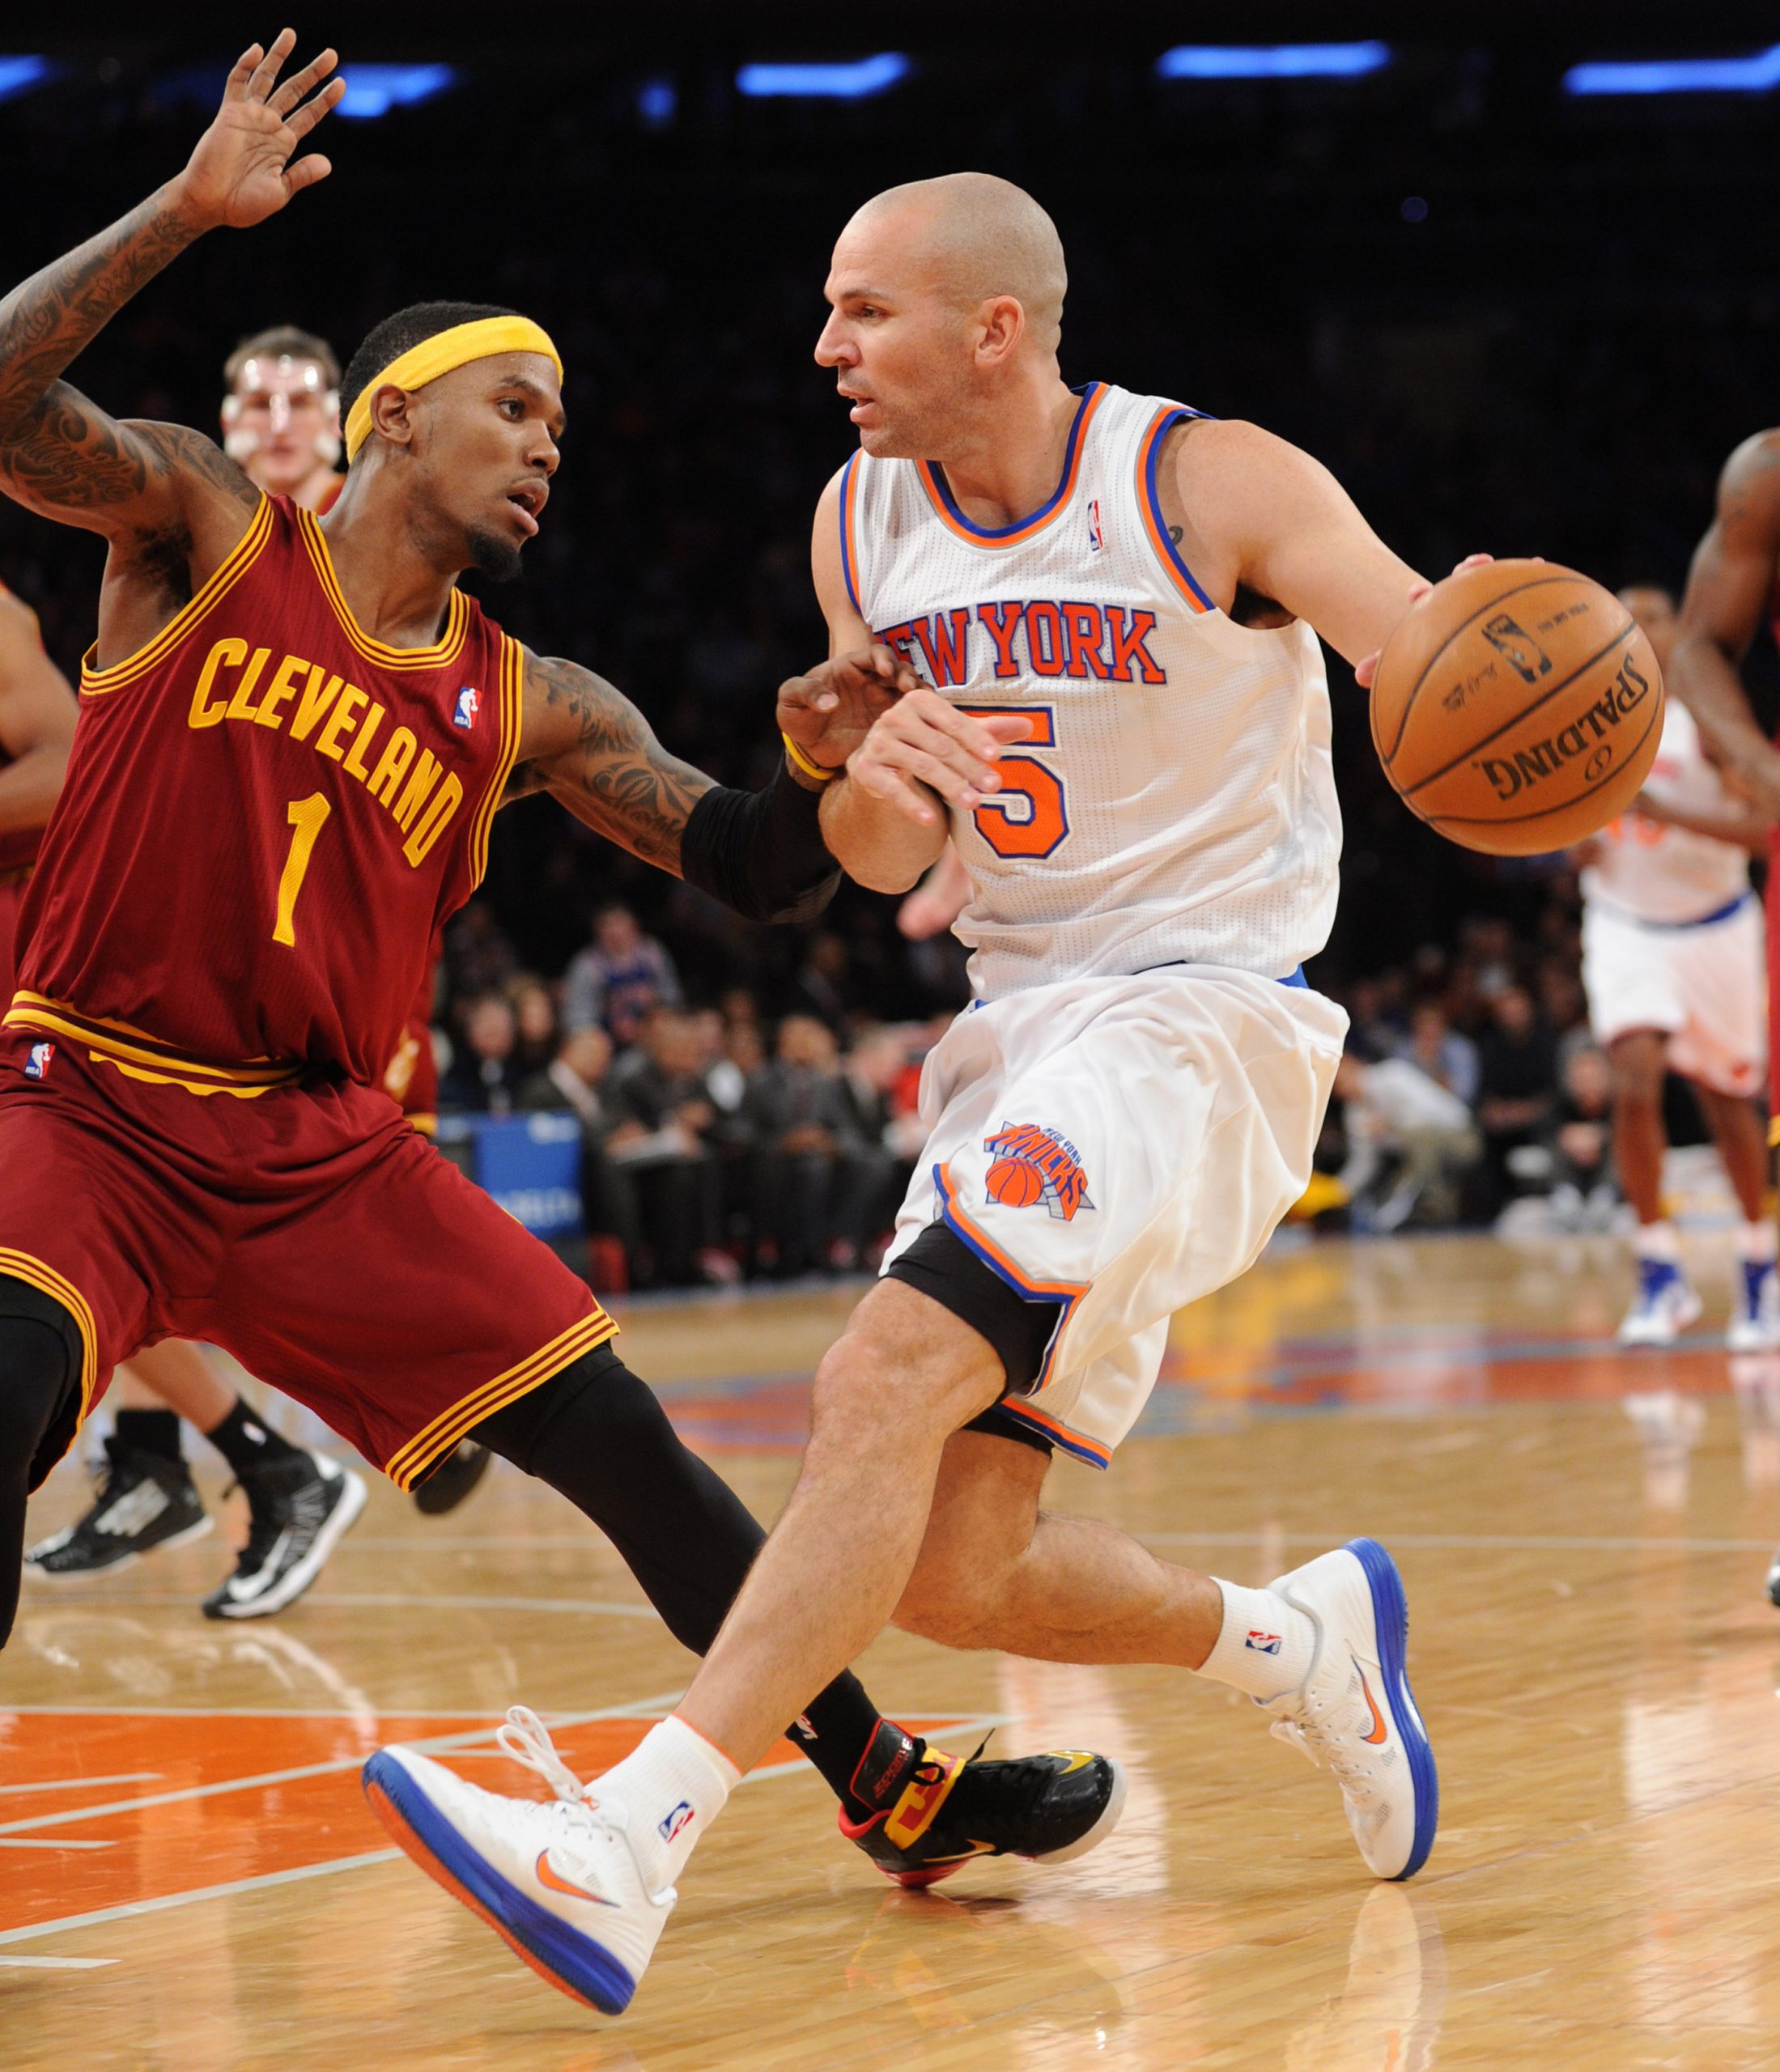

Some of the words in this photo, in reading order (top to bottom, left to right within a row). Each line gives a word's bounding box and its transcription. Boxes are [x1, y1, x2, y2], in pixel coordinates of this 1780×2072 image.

[875, 607, 970, 688] EW
[977, 600, 1166, 684] YORK
[188, 638, 463, 868] CLEVELAND
[952, 705, 1070, 860] 5
[1481, 652, 1649, 800] SPALDING
[272, 792, 331, 947] 1
[983, 1123, 1088, 1222] KNICKS
[1043, 1127, 1066, 1142] NEW
[1063, 1140, 1082, 1166] YORK
